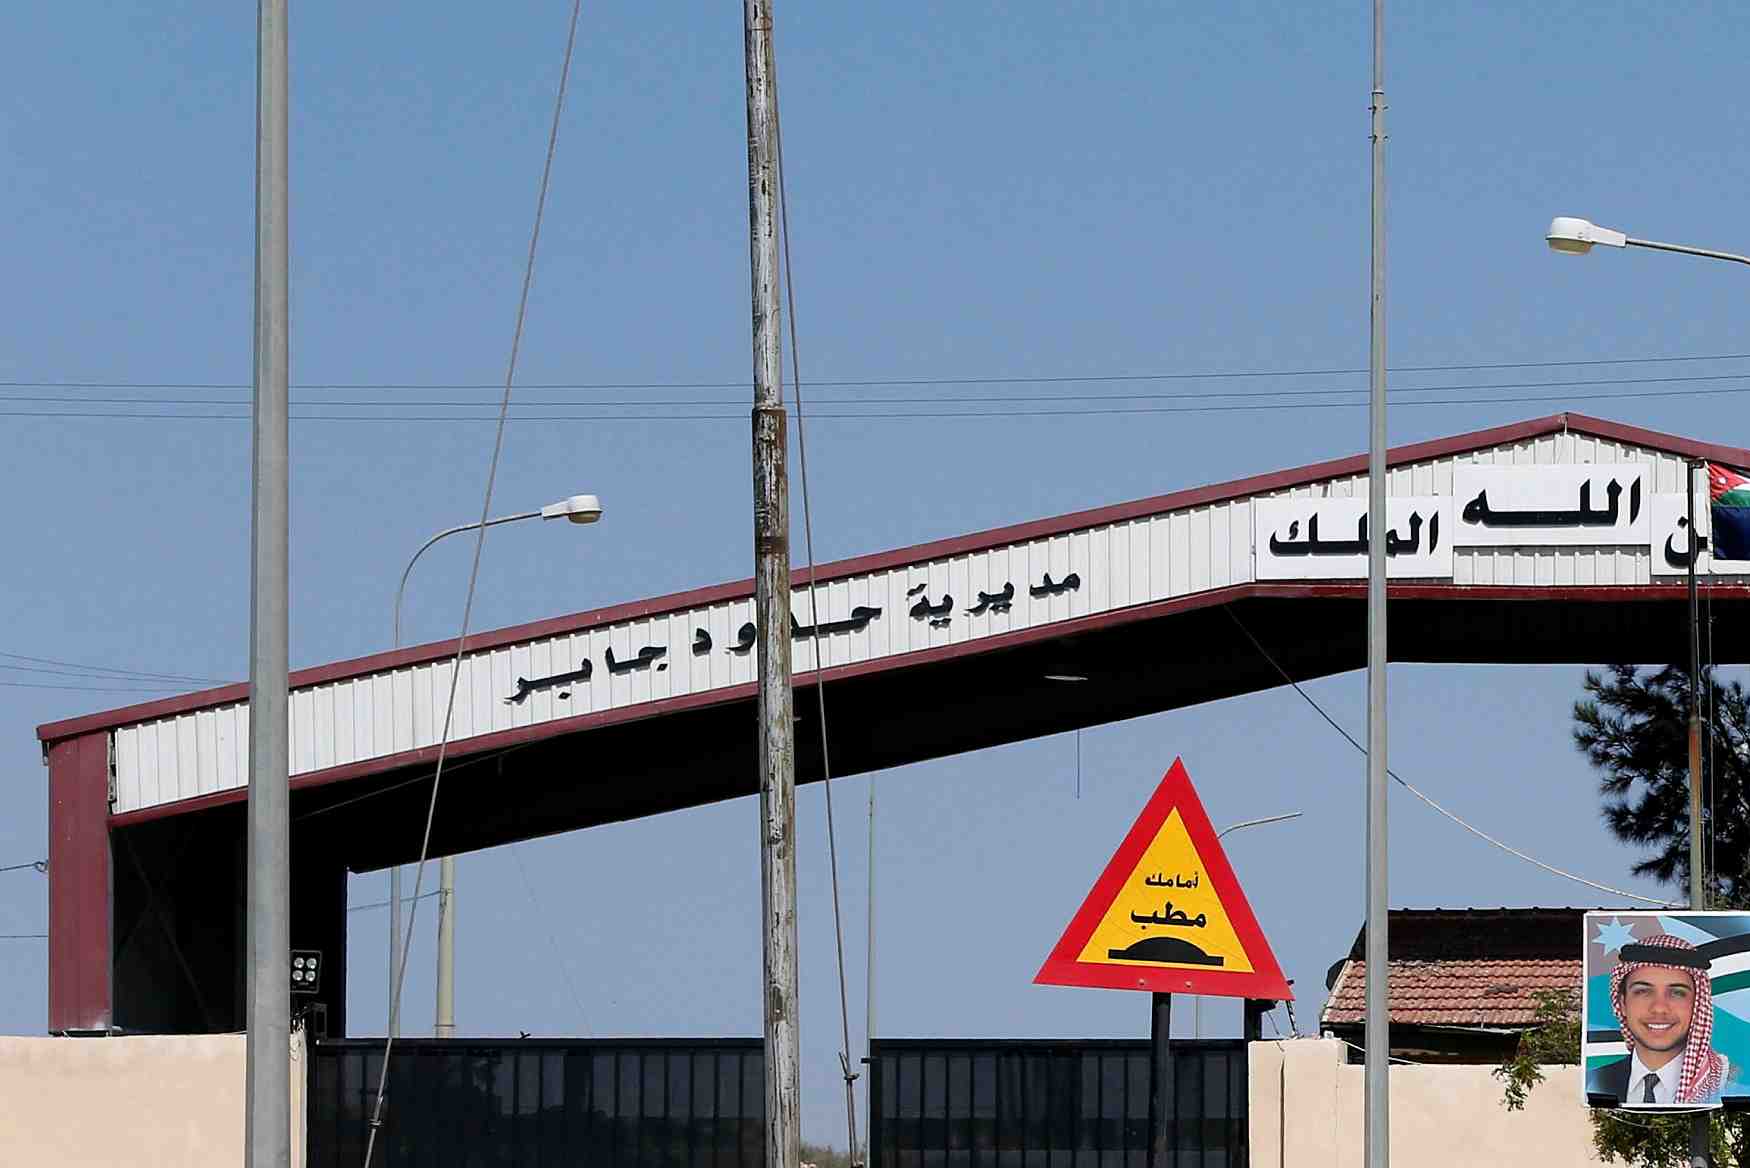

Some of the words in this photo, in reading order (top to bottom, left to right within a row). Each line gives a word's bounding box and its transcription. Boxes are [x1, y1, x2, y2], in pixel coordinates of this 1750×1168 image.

[1462, 476, 1641, 528] الله
[1269, 511, 1439, 557] الملك
[907, 572, 1082, 628] مديرية
[504, 646, 668, 703] جابر
[1144, 871, 1199, 889] أمامك
[1130, 901, 1207, 930] مطب
